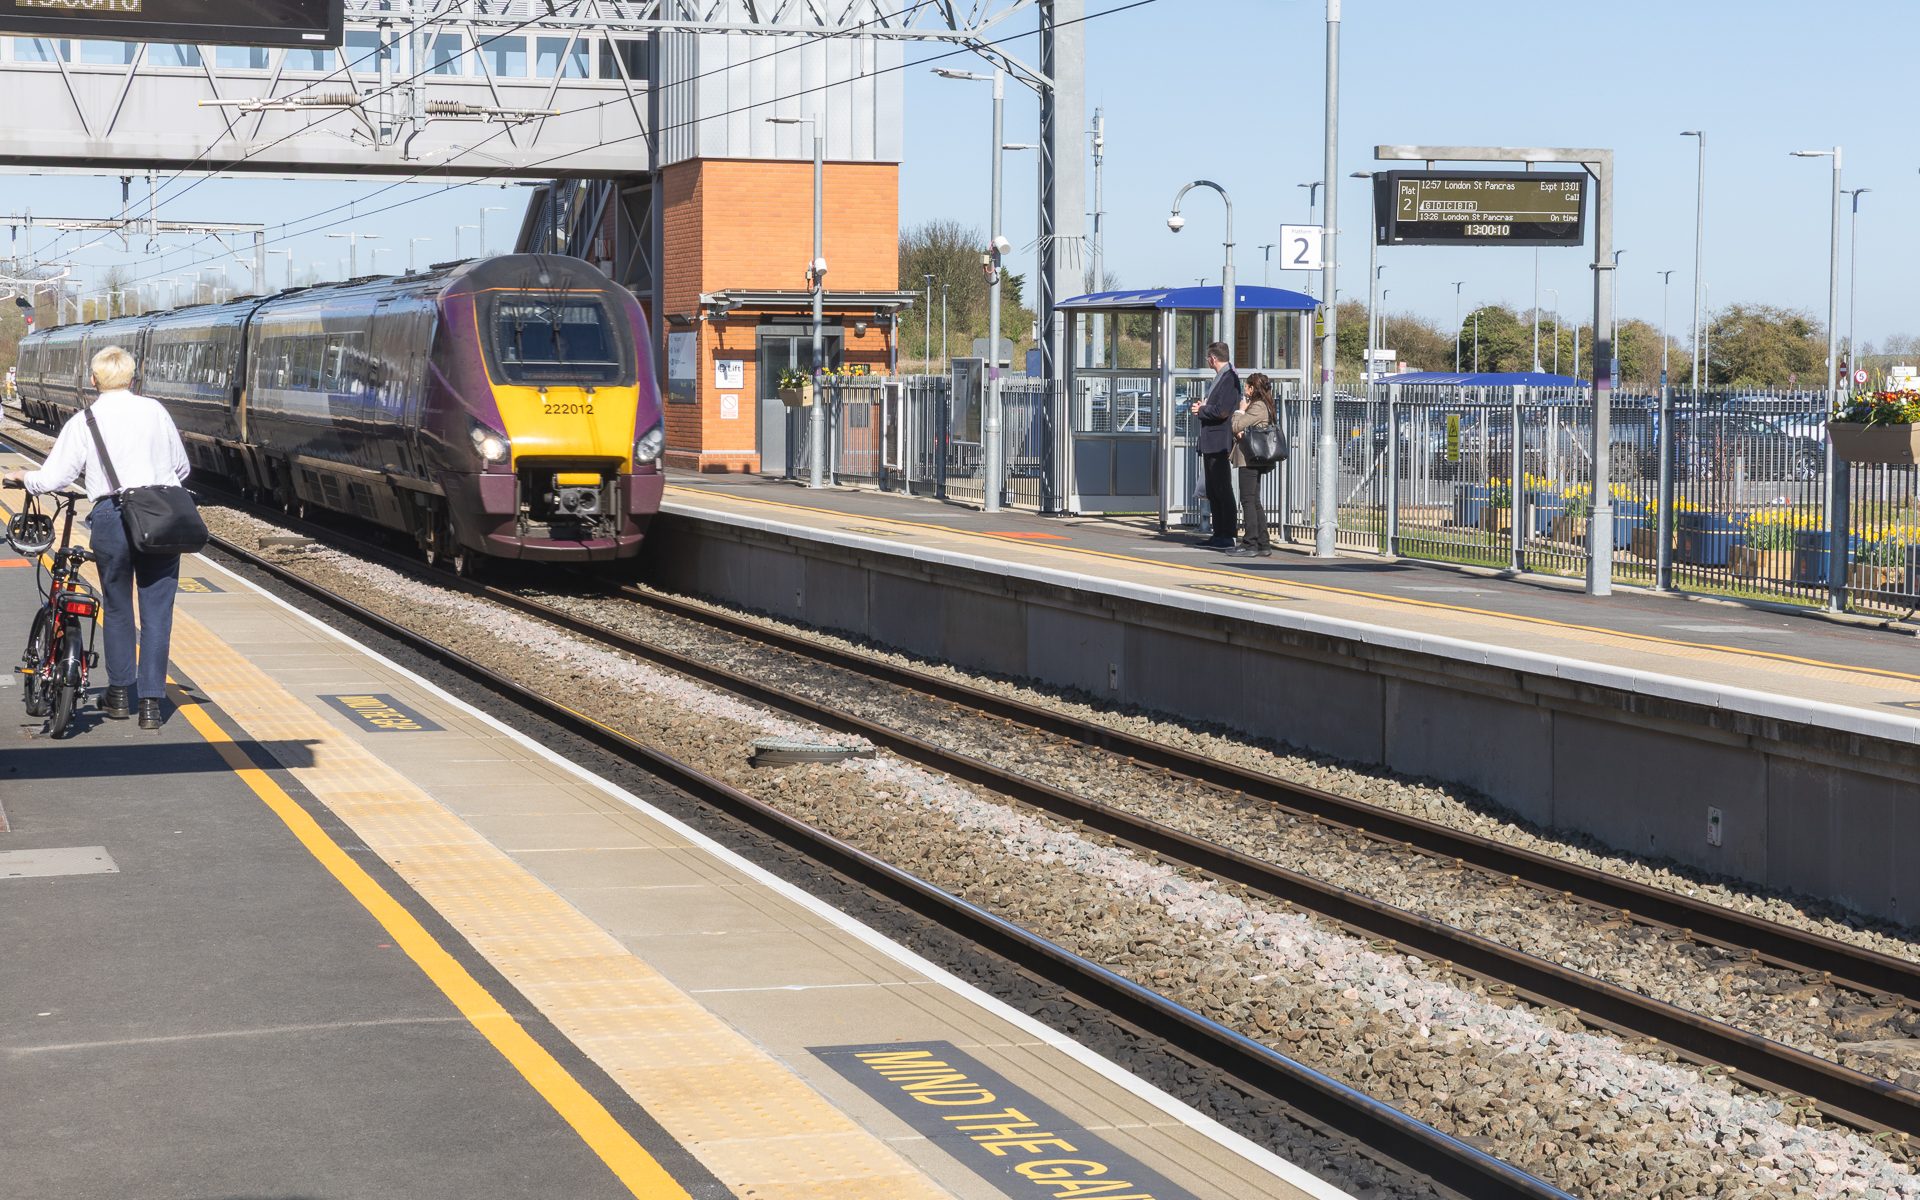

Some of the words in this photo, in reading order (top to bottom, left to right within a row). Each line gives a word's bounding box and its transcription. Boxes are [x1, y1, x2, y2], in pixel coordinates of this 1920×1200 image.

[1401, 185, 1416, 195] Plat
[1422, 180, 1442, 190] 12:57
[1444, 180, 1471, 190] London
[1473, 181, 1483, 190] St
[1484, 181, 1516, 191] Pancras
[1540, 181, 1558, 193] Expt
[1560, 182, 1579, 191] 13:01
[1403, 198, 1412, 211] 2
[1420, 212, 1439, 221] 13:26
[1442, 213, 1469, 221] London
[1471, 213, 1481, 221] St
[1482, 213, 1514, 222] Pancras
[1550, 214, 1560, 222] On
[1562, 214, 1578, 222] time
[1467, 224, 1510, 236] 13:00:10
[1293, 237, 1310, 264] 2
[1859, 372, 1865, 381] 5
[543, 403, 595, 415] 222012
[853, 1050, 997, 1106] MIND
[942, 1107, 1079, 1156] THE
